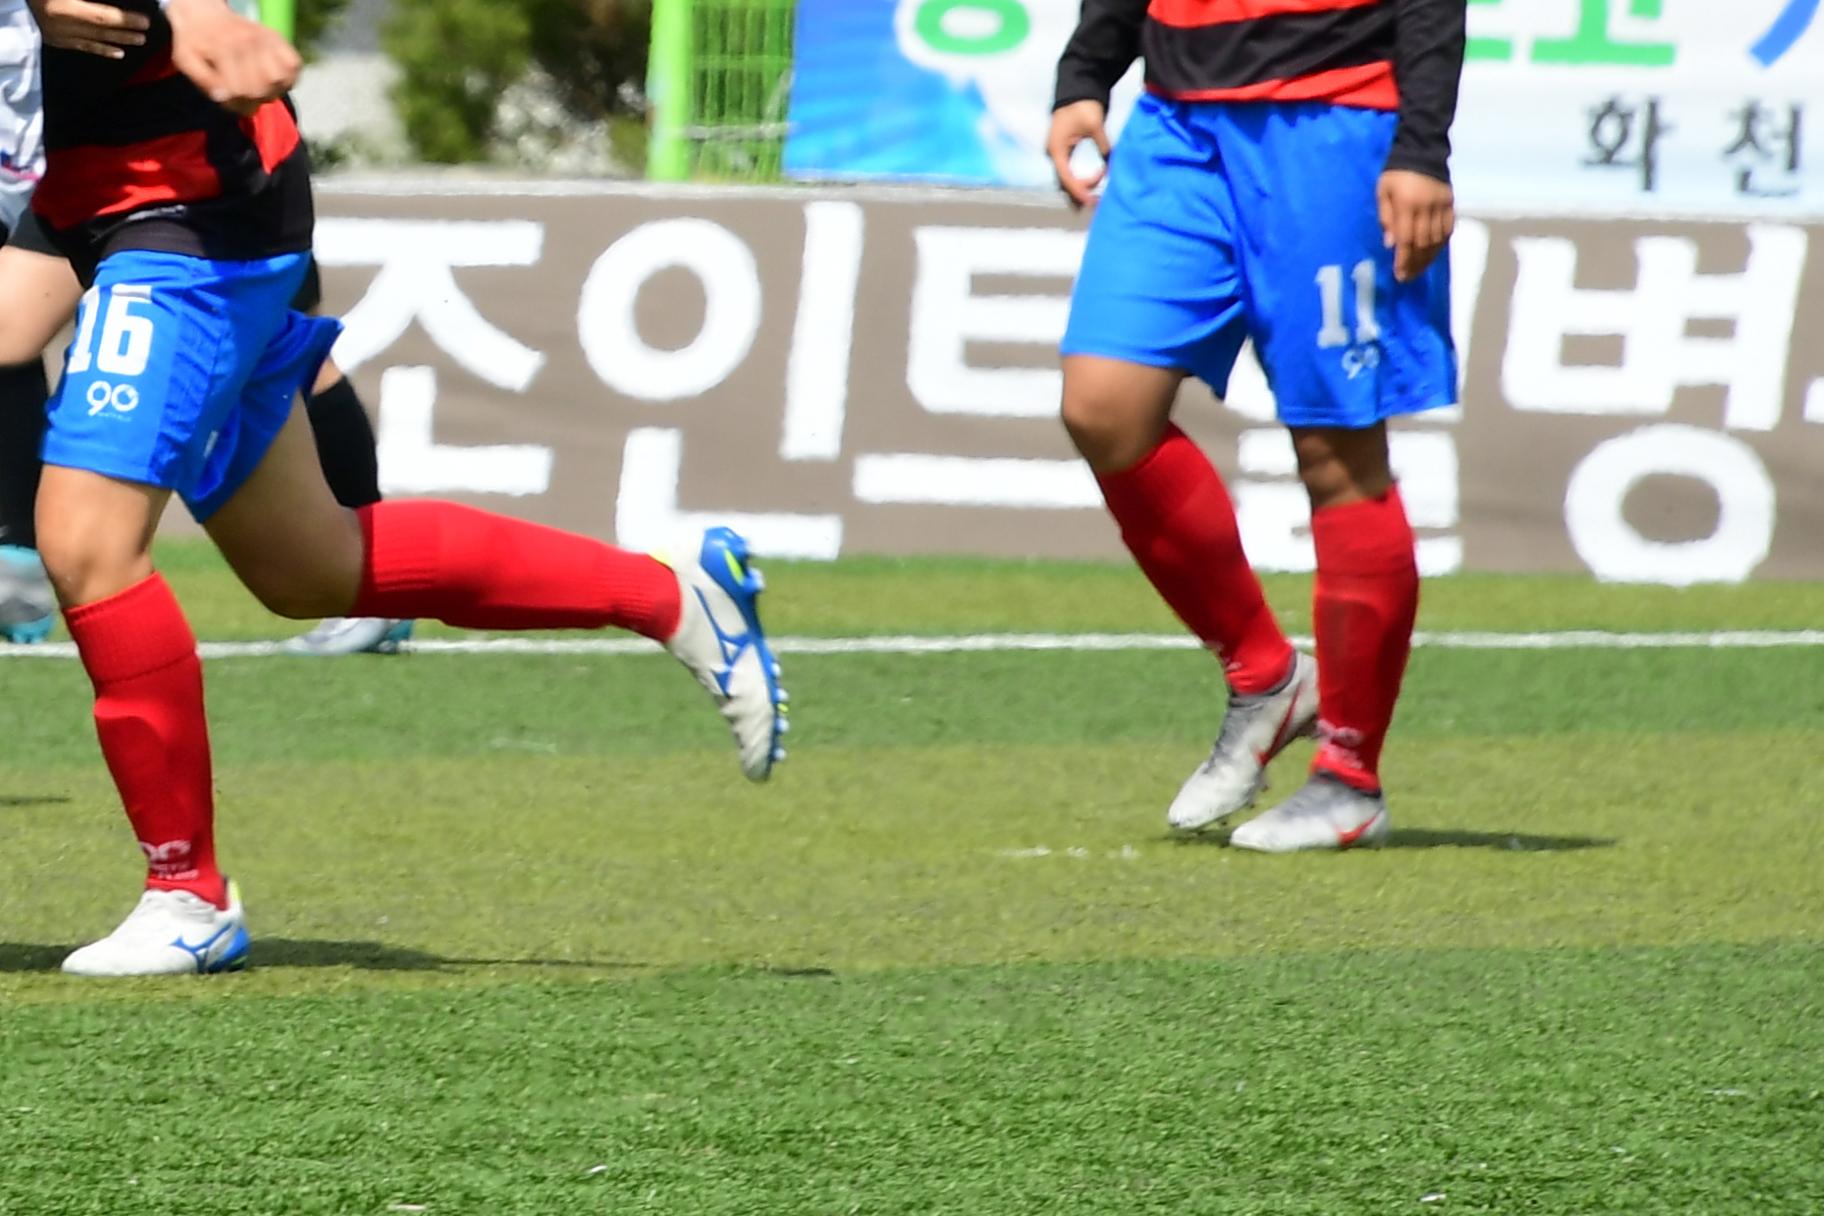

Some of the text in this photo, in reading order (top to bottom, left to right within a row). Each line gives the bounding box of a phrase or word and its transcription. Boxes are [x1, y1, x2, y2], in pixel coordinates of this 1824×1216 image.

[66, 283, 154, 376] 16
[1314, 258, 1382, 350] 11
[86, 380, 140, 417] 90
